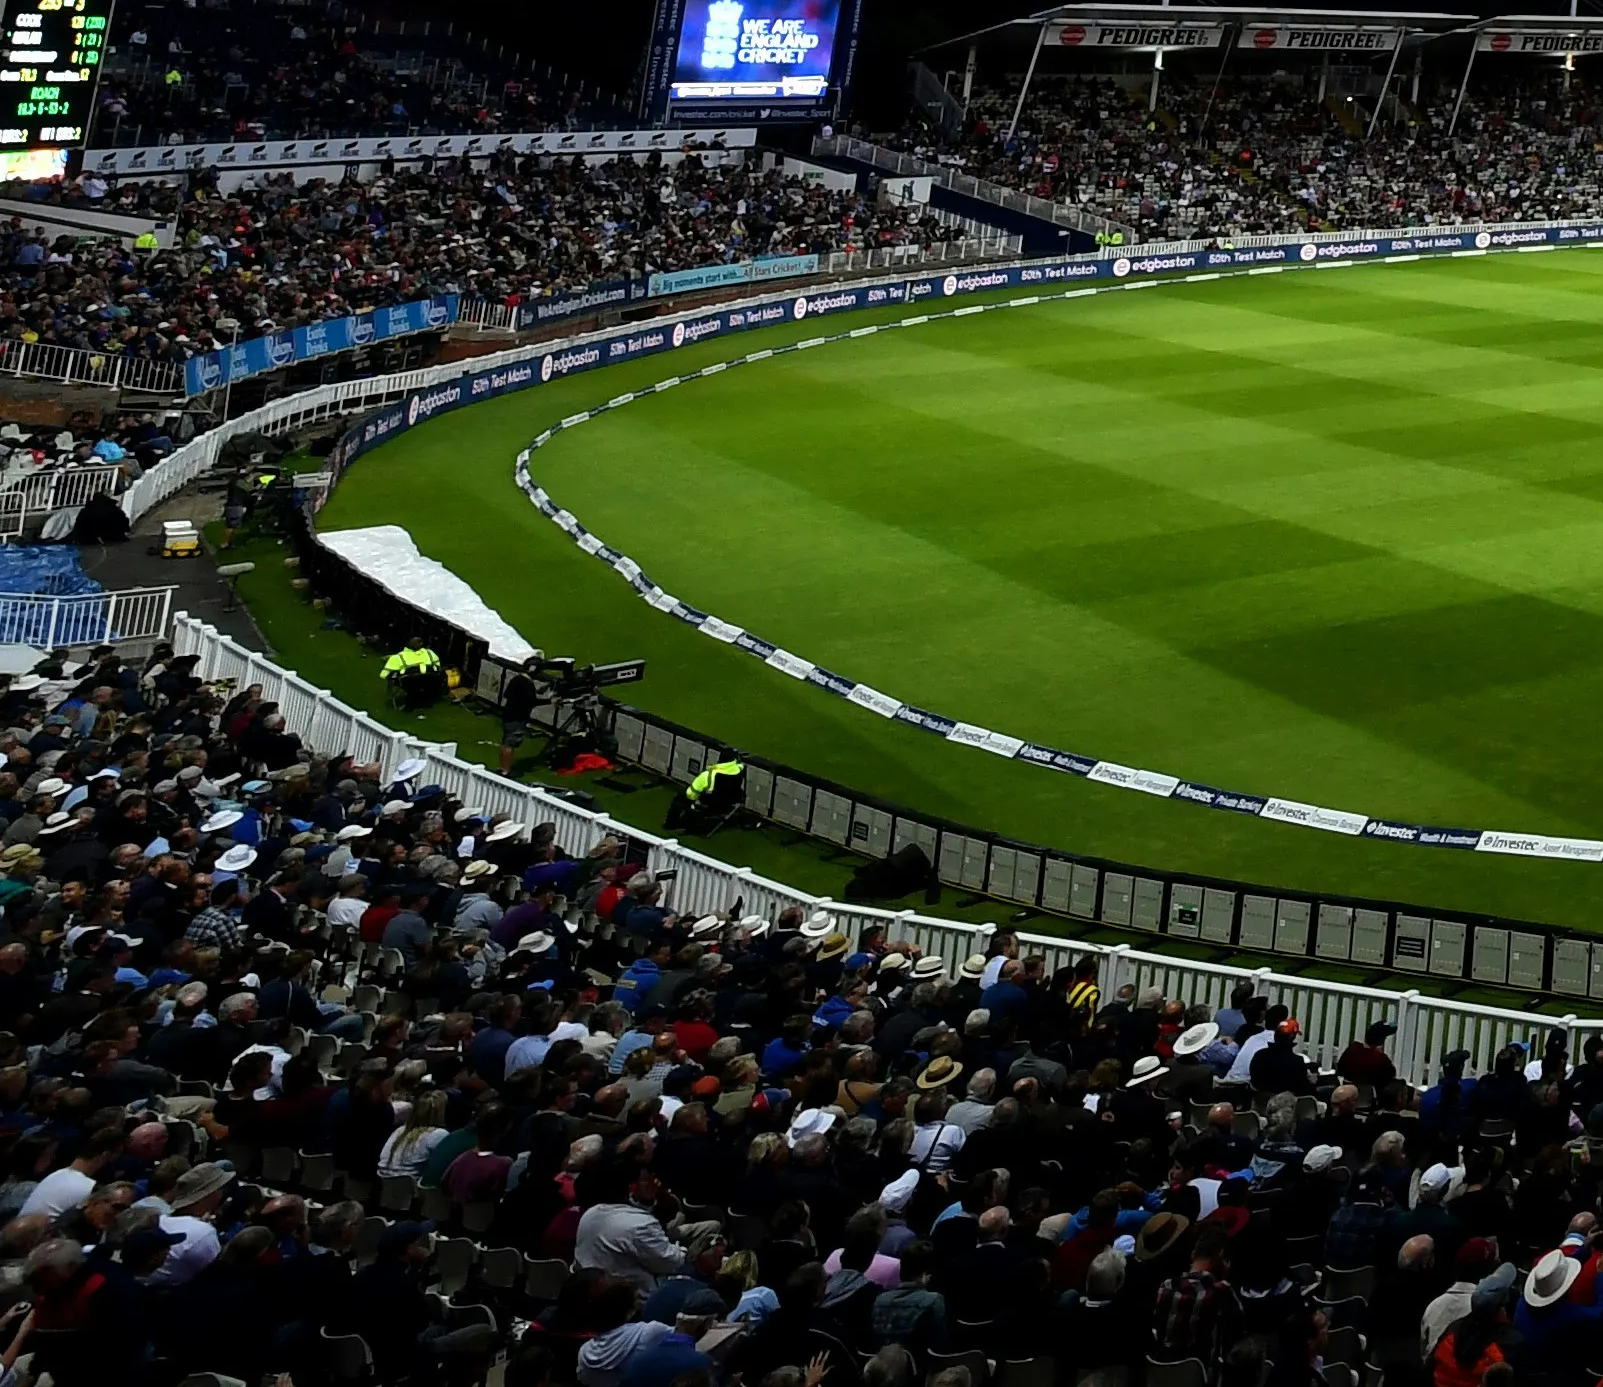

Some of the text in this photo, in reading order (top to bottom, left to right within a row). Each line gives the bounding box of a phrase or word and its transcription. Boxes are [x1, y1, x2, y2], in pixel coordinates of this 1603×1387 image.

[743, 20, 804, 34] WE ARE
[741, 35, 818, 49] ENGLAND
[1097, 29, 1200, 45] PEDIGREE
[1286, 31, 1375, 49] PEDIGREE
[1520, 36, 1602, 52] PEDIGREE
[738, 49, 807, 63] CRICKET
[660, 47, 673, 90] Investec
[1492, 230, 1546, 244] edgbaston
[1560, 230, 1578, 239] 50th
[1581, 228, 1599, 237] Test
[1318, 243, 1377, 258] edgbaston
[1392, 237, 1461, 250] 50th Test Match
[1132, 256, 1195, 272] edgbaston
[1209, 249, 1285, 264] 50th Test Match
[663, 280, 675, 291] Big
[676, 276, 703, 288] moments
[705, 272, 724, 285] start
[755, 265, 771, 276] Stars
[1021, 264, 1097, 281] 50th Test Match
[958, 274, 1008, 290] edgbaston
[808, 294, 856, 313] edgbaston
[389, 308, 408, 321] Exotic
[729, 307, 784, 326] 50th Test Match
[307, 325, 326, 341] Exotic
[389, 322, 409, 334] Drinks
[684, 319, 721, 338] edgbaston
[306, 342, 328, 355] Drinks
[610, 335, 664, 357] 50th Test Match
[553, 348, 599, 372] edgbaston
[472, 369, 531, 394] 50th Test Match
[419, 387, 460, 414] edgbaston
[1493, 836, 1601, 857] Investec Asset Management
